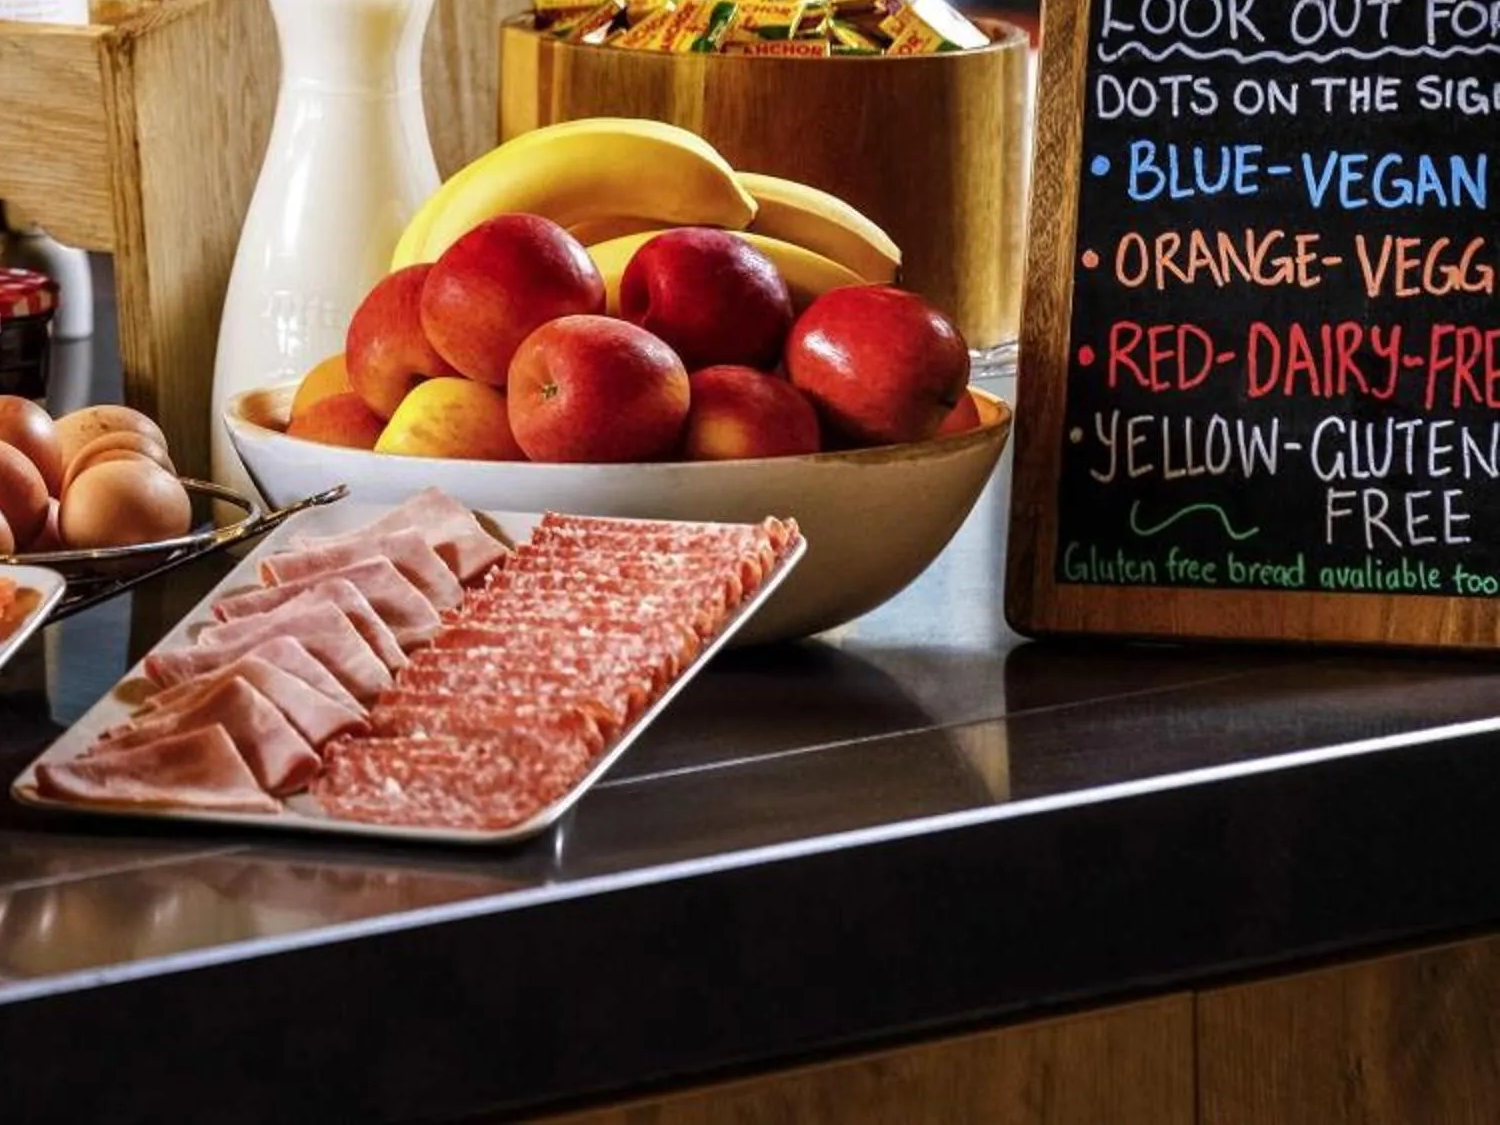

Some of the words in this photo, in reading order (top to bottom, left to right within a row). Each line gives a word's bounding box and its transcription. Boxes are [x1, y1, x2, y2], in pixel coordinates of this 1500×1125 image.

[1096, 74, 1218, 119] DOTS
[1233, 79, 1299, 116] ON
[1310, 75, 1402, 115] THE
[1127, 139, 1488, 210] BLUE-VEGAN
[1090, 408, 1500, 484] YELLOW-GLUTEN
[1326, 487, 1472, 550] FREE
[1064, 541, 1156, 584] Gluten
[1165, 546, 1218, 583] free
[1228, 551, 1305, 587] bread
[1320, 554, 1442, 590] avaliable
[1452, 563, 1499, 594] too
